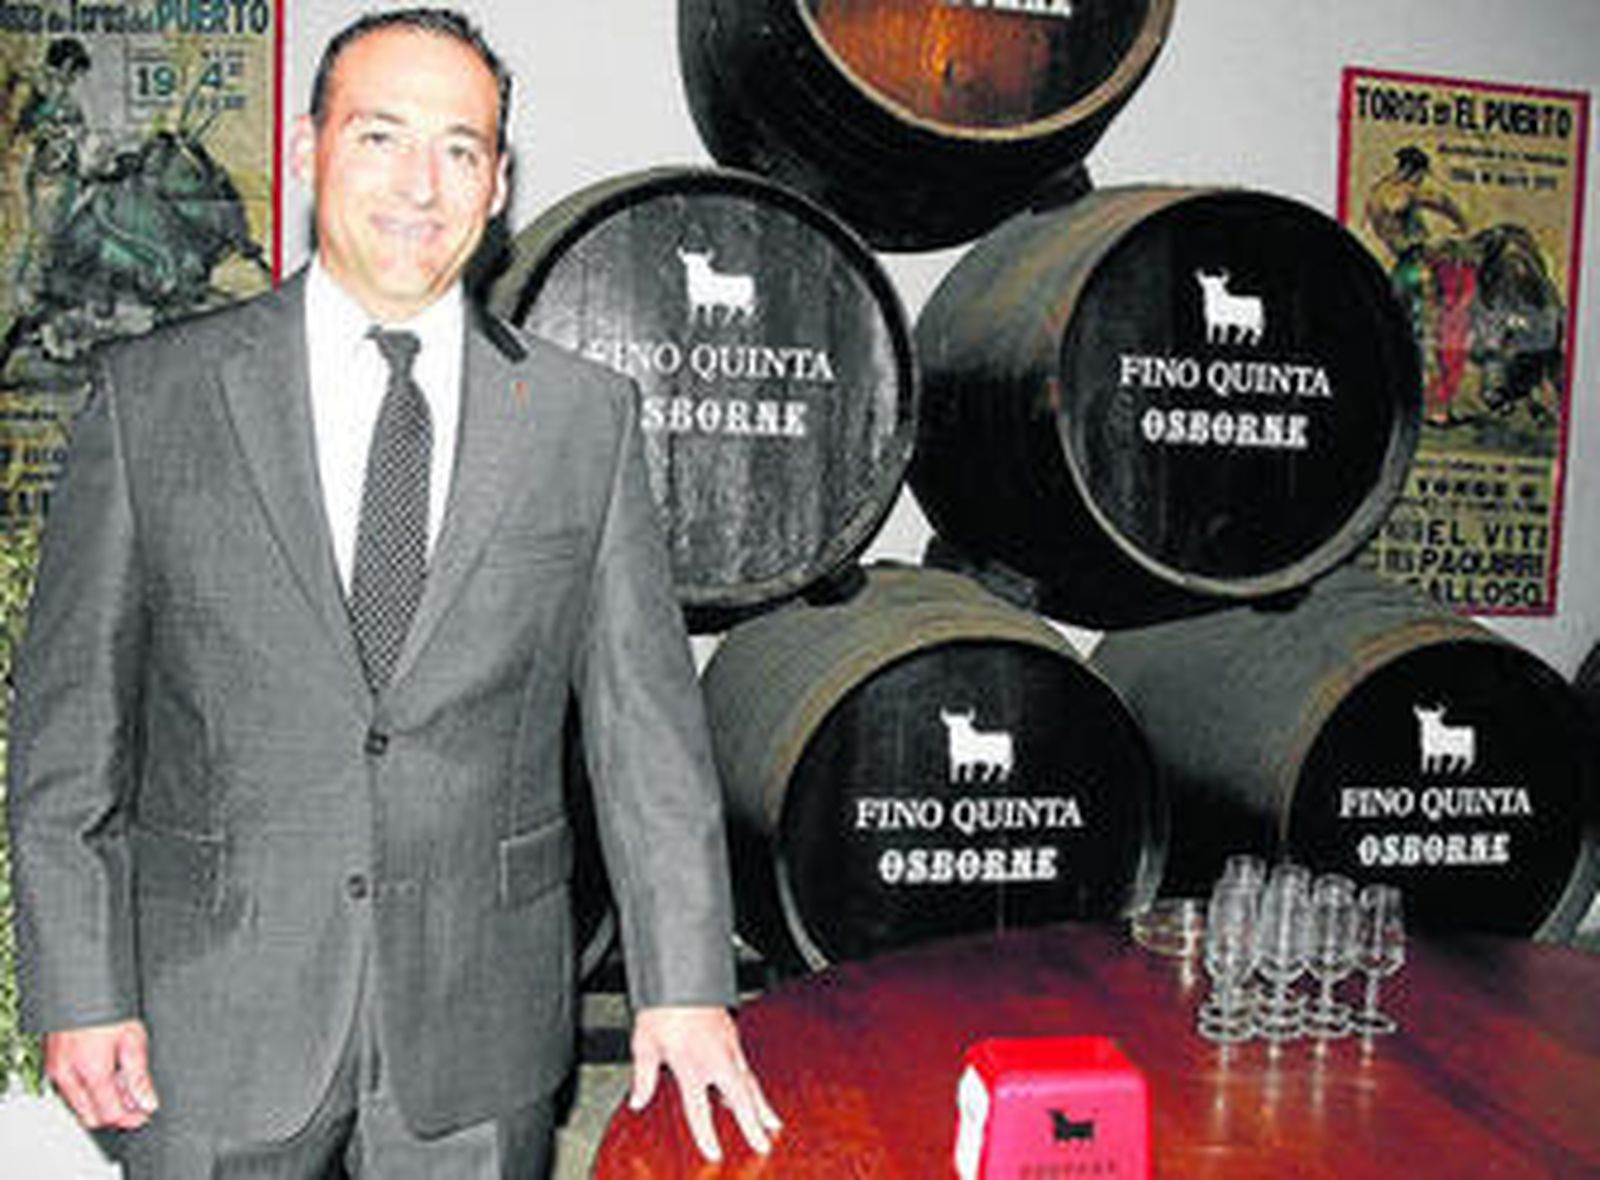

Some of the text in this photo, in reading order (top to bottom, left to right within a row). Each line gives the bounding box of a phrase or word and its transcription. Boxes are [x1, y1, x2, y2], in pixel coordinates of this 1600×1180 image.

[155, 0, 269, 34] PUERTO
[1356, 86, 1430, 125] TOROS
[1455, 95, 1479, 130] EL
[1484, 100, 1573, 139] PUERTO
[690, 343, 835, 382] QUINTA
[1119, 354, 1332, 397] FINO QUINTA
[641, 399, 807, 436] SBORNE
[1142, 407, 1309, 448] OSBORNE
[1427, 519, 1466, 546] EL
[1483, 521, 1548, 550] VITI
[1406, 577, 1544, 609] ALLOSO
[856, 798, 1084, 835] FINO QUINTA
[1340, 786, 1532, 820] FINO QUINTA
[879, 848, 1058, 884] OSBORNE
[1357, 832, 1510, 866] OSBORNE
